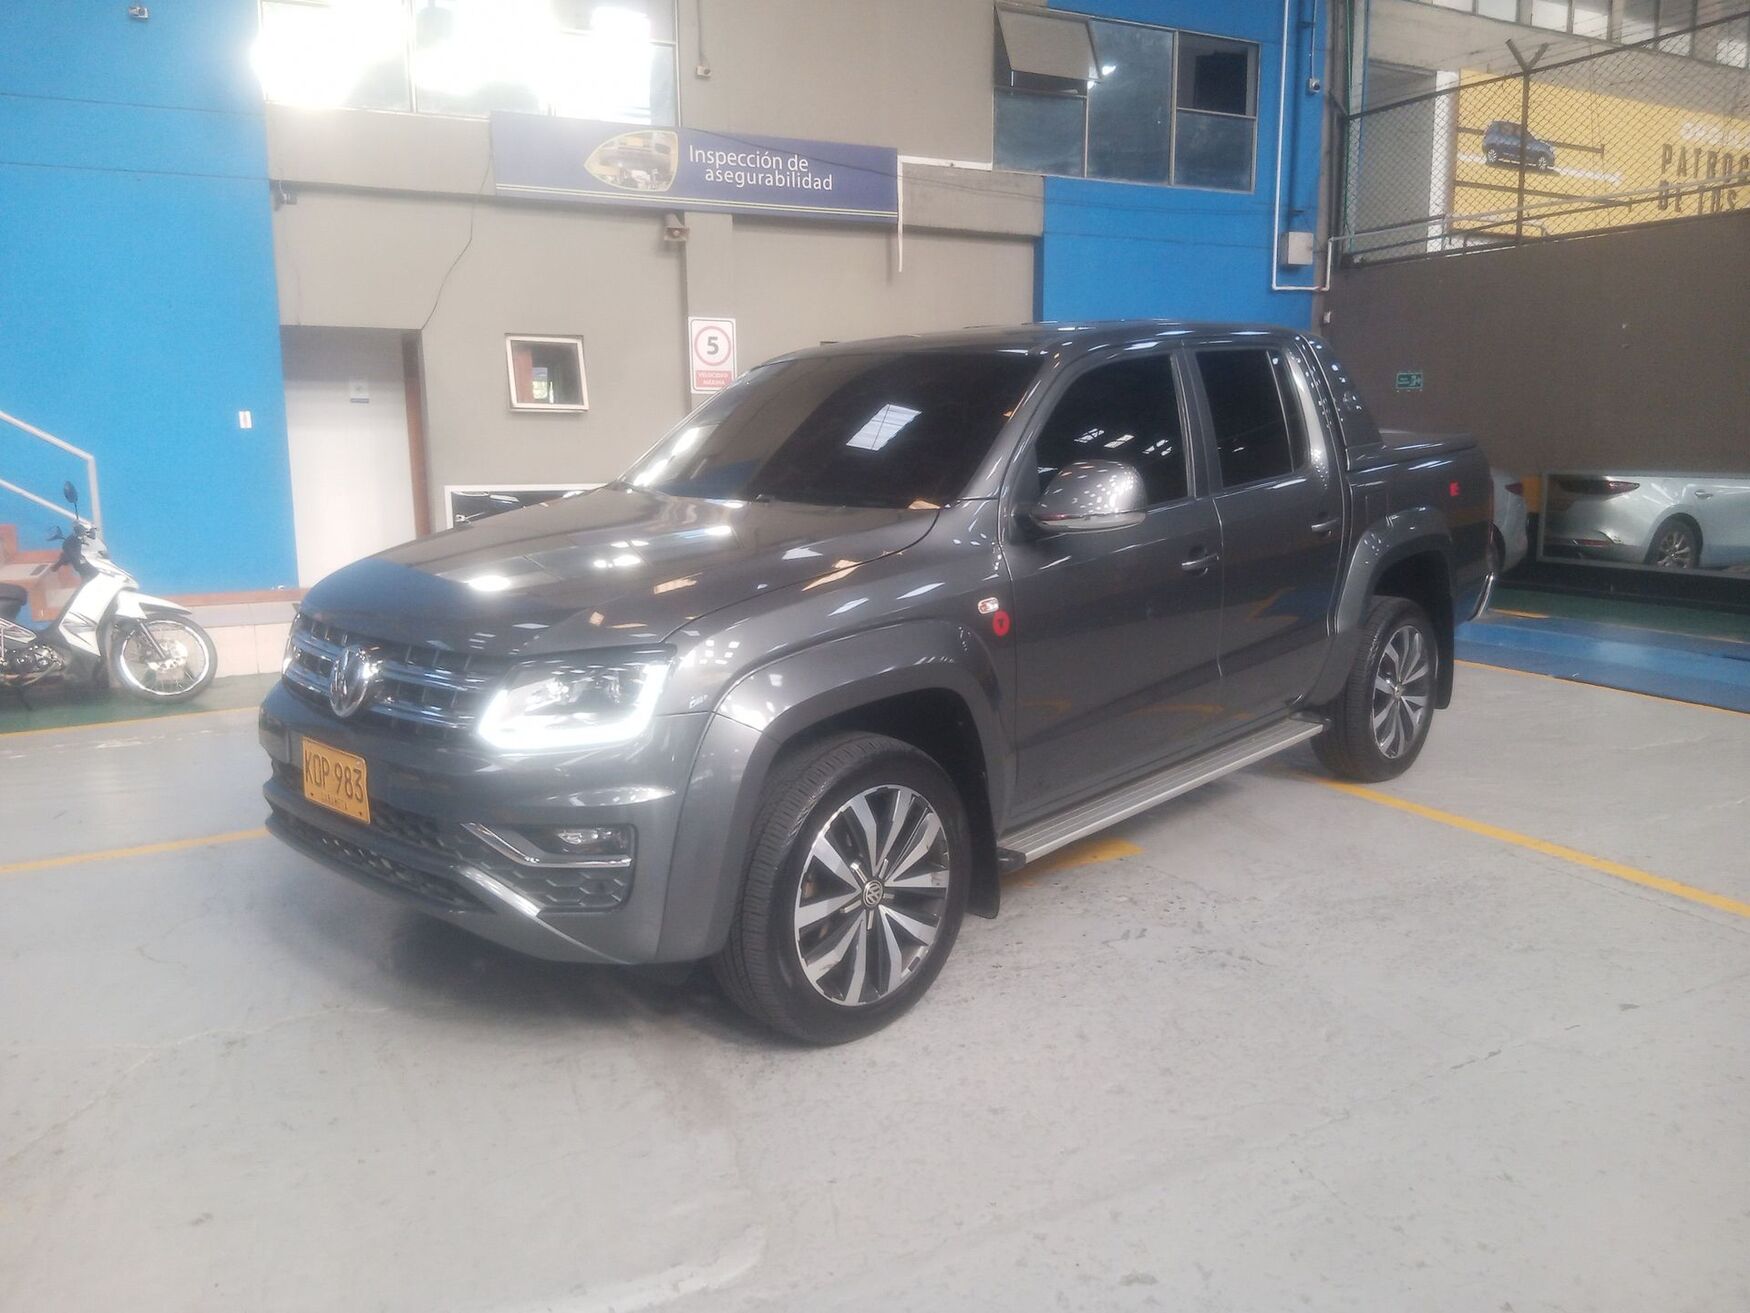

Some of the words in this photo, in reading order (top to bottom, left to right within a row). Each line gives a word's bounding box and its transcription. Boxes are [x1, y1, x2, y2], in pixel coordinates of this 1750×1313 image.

[689, 145, 783, 170] Inspección
[787, 154, 809, 172] de
[705, 167, 833, 191] asegurabilidad
[707, 336, 719, 355] 5
[334, 762, 364, 804] 983
